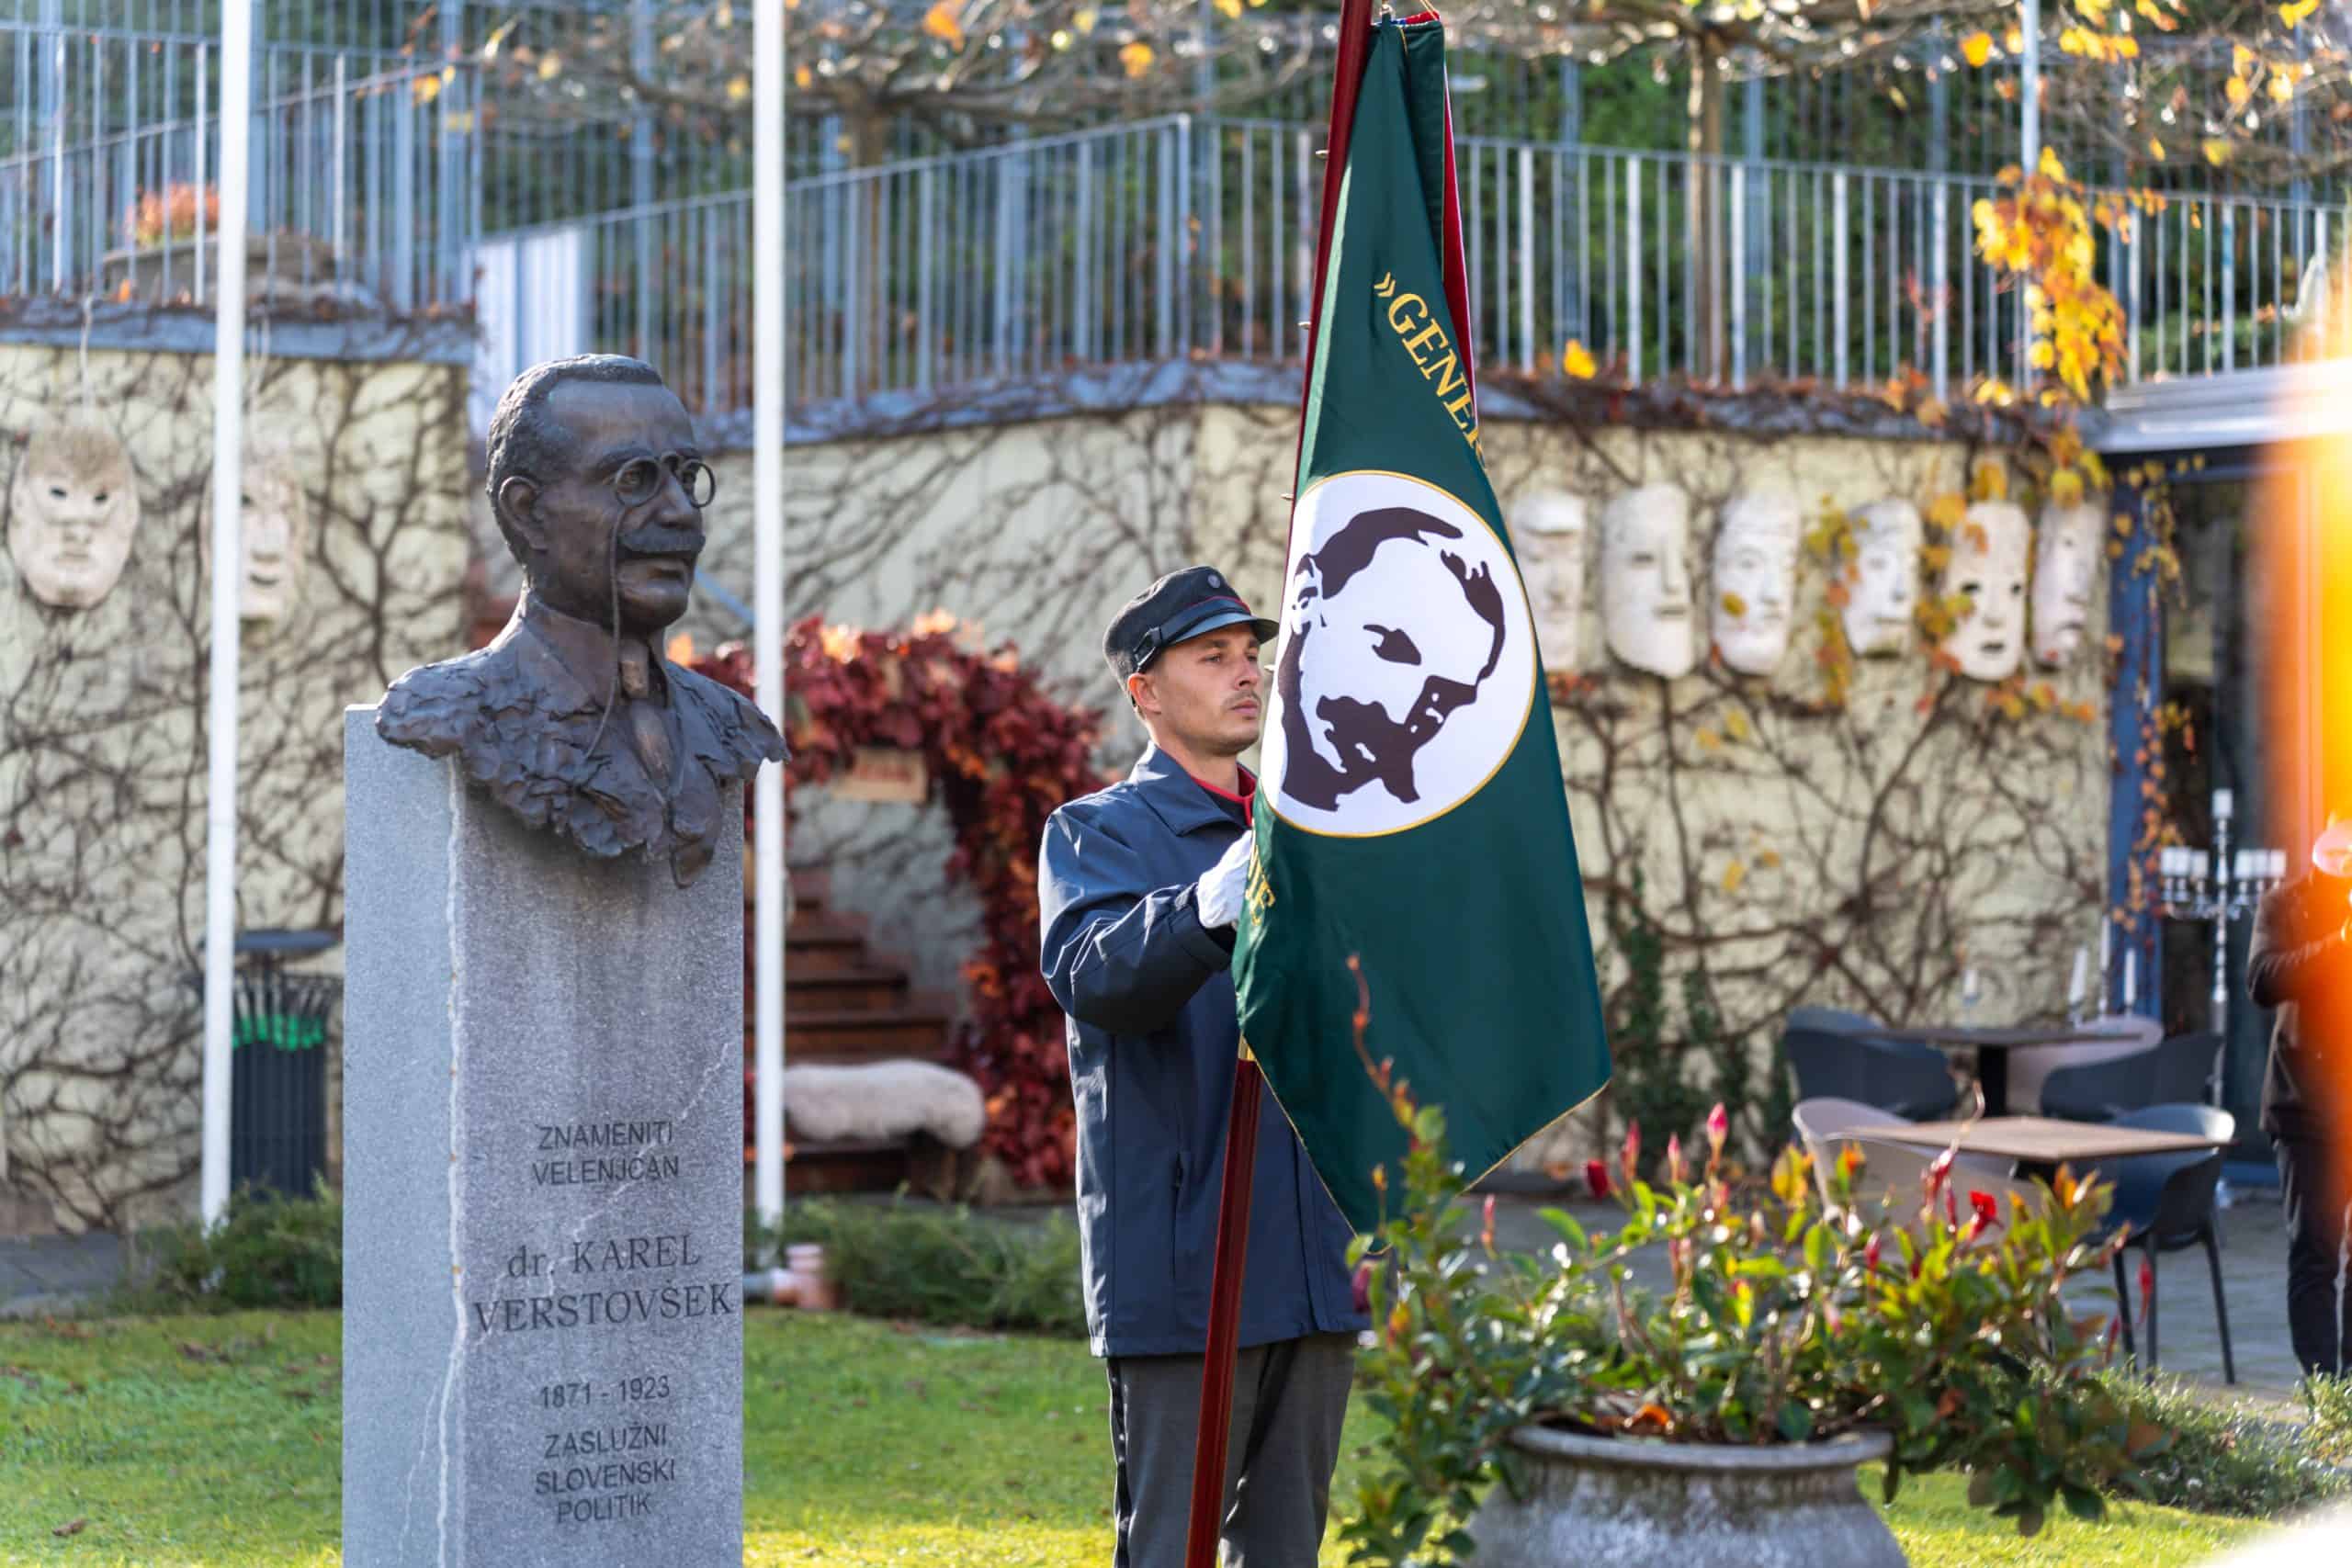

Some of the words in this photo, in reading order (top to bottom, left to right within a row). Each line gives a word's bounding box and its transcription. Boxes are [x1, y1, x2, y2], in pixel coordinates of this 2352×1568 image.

[537, 1121, 673, 1150] ZNAMENITI
[532, 1150, 679, 1186] VELENJČAN
[507, 1244, 555, 1278] dr.
[571, 1234, 701, 1274] KAREL
[475, 1279, 733, 1333] VERSTOVŠEK
[540, 1382, 592, 1409] 1871
[619, 1375, 670, 1401] 1923
[544, 1421, 667, 1459] ZASLUŽNI
[535, 1459, 675, 1495] SLOVENSKI
[557, 1493, 653, 1524] POLITIK
